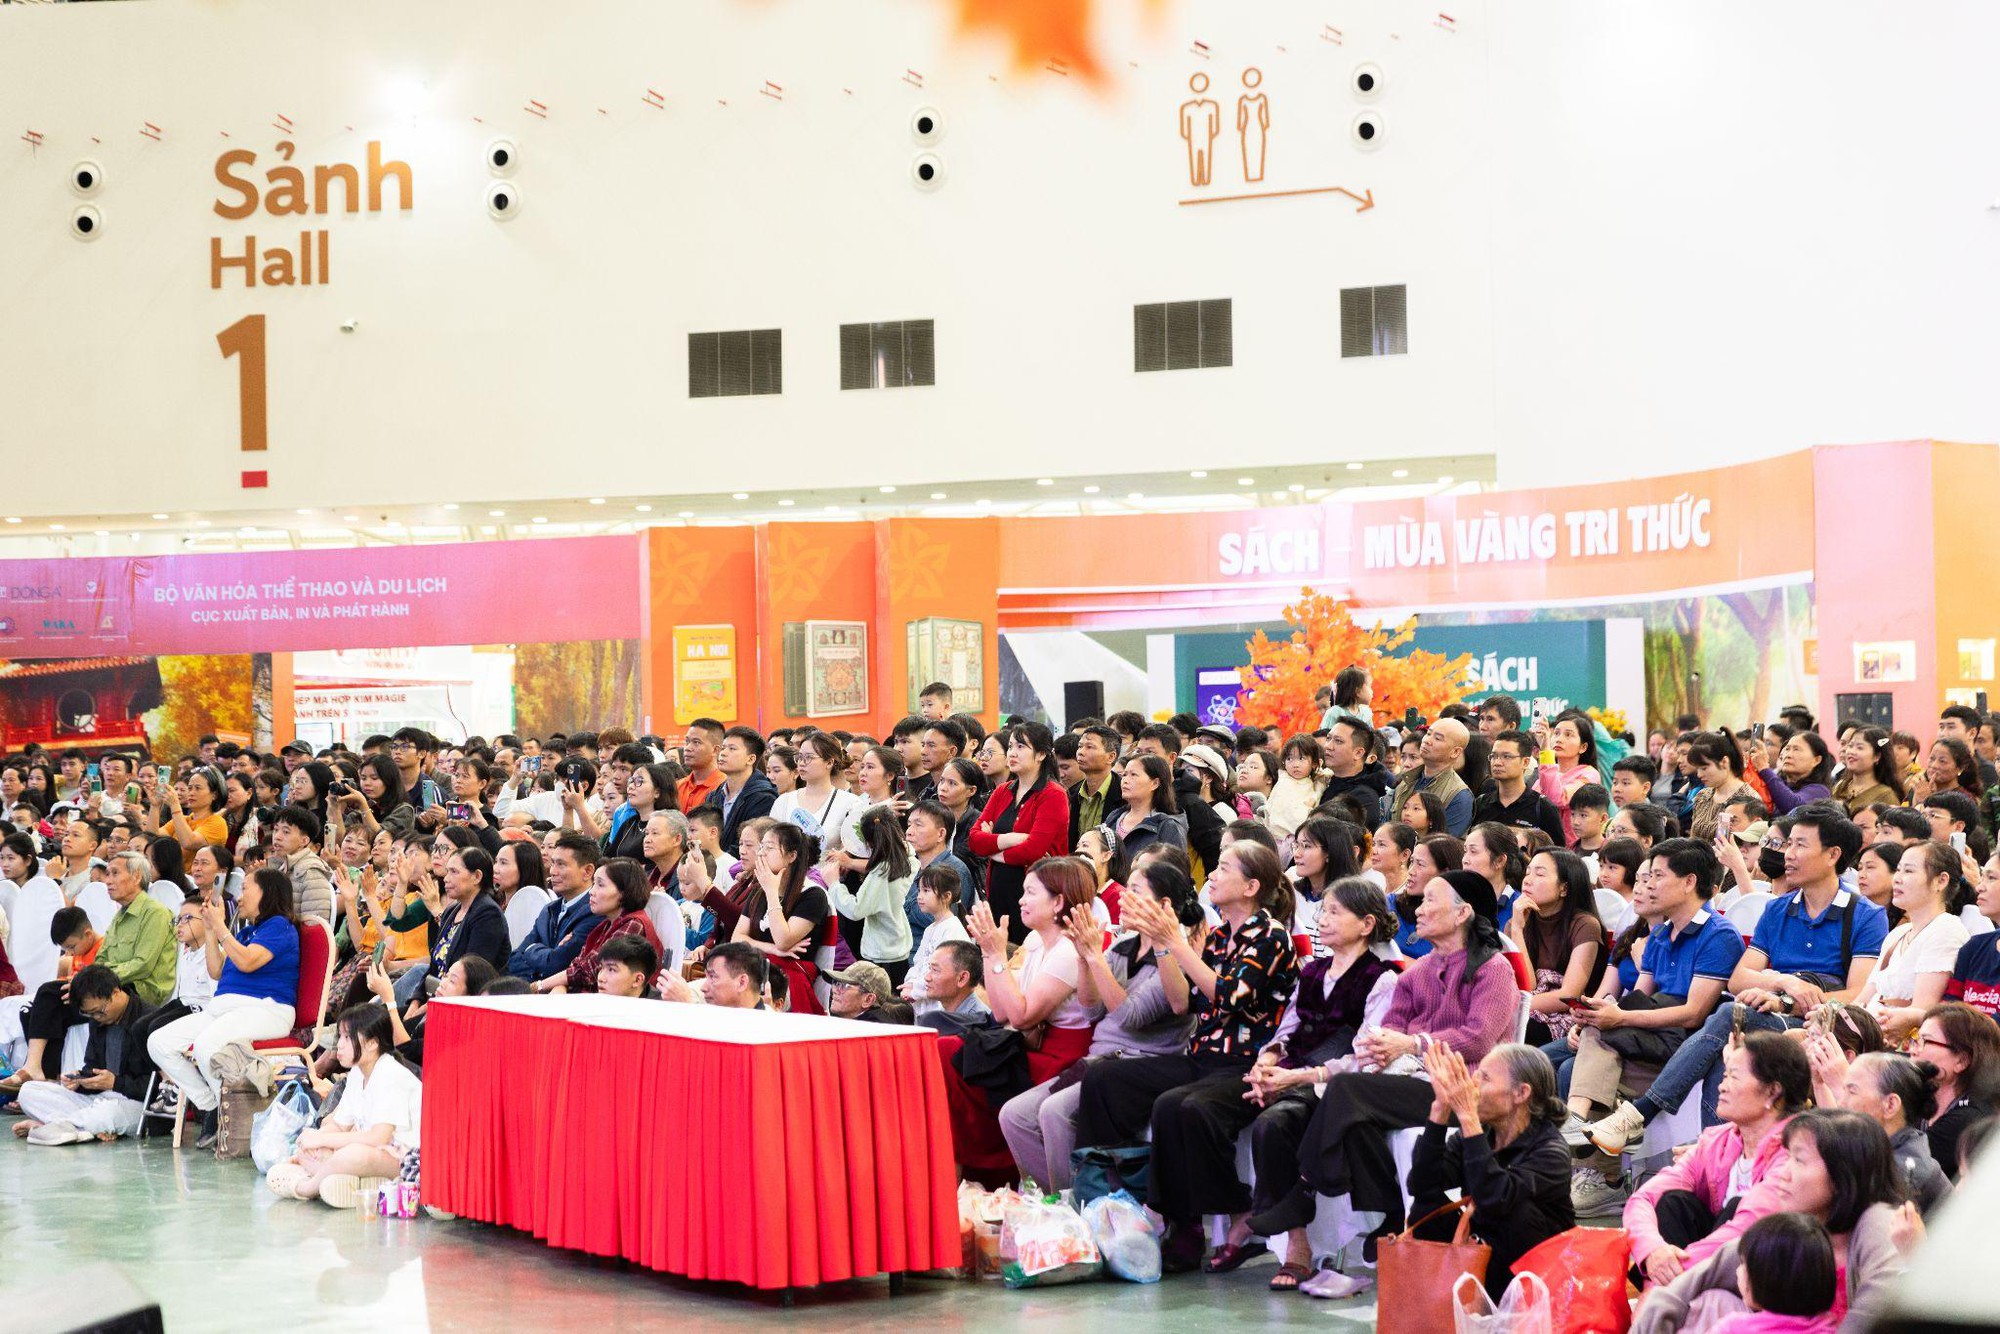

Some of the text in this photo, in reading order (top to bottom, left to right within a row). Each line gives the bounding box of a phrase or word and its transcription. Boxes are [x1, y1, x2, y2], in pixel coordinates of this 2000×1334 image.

[213, 140, 413, 220] Sảnh
[211, 230, 329, 289] Hall
[215, 314, 268, 452] 1
[1218, 524, 1320, 577] SÁCH
[1364, 516, 1447, 569] MÙA
[1455, 509, 1557, 564] VÀNG
[1565, 508, 1619, 558] TRI
[1627, 492, 1711, 553] THỨC
[154, 583, 179, 606] BỘ
[182, 583, 218, 602] VĂN
[298, 580, 348, 598] THAO
[350, 576, 375, 596] VÀ
[378, 578, 404, 595] DU
[406, 577, 447, 598] LỊCH
[191, 609, 220, 626] CỤC
[223, 604, 259, 622] XUẤT
[295, 605, 310, 620] IN
[311, 603, 331, 619] VÀ
[333, 602, 369, 618] PHÁT
[371, 601, 410, 617] HÀNH
